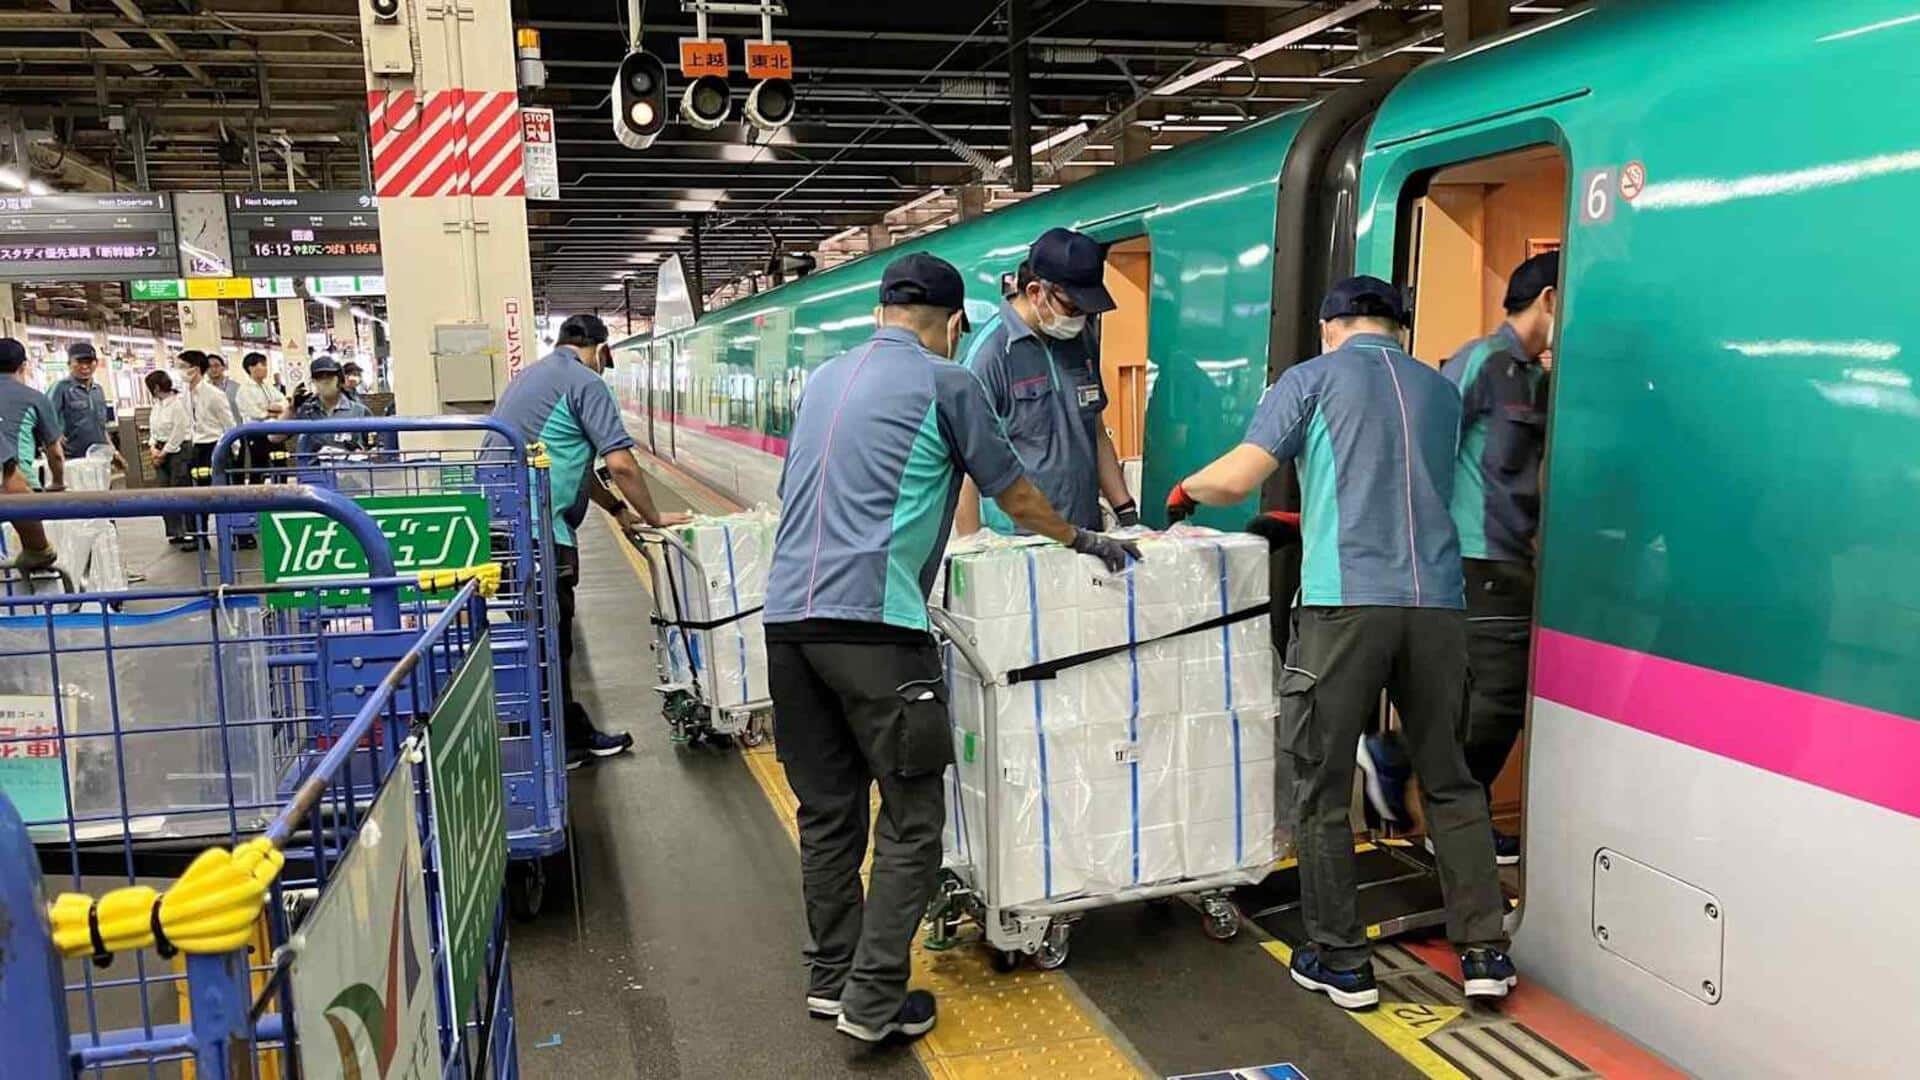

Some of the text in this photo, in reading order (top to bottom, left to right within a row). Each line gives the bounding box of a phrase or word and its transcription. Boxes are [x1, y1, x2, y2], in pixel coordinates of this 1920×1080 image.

[685, 52, 724, 67] 上越
[751, 54, 790, 69] 東北
[524, 113, 549, 122] STOP
[1588, 172, 1607, 219] 6
[262, 199, 298, 207] Departure
[255, 243, 291, 256] 16:12
[241, 323, 254, 334] 16
[1394, 1004, 1442, 1028] 12
